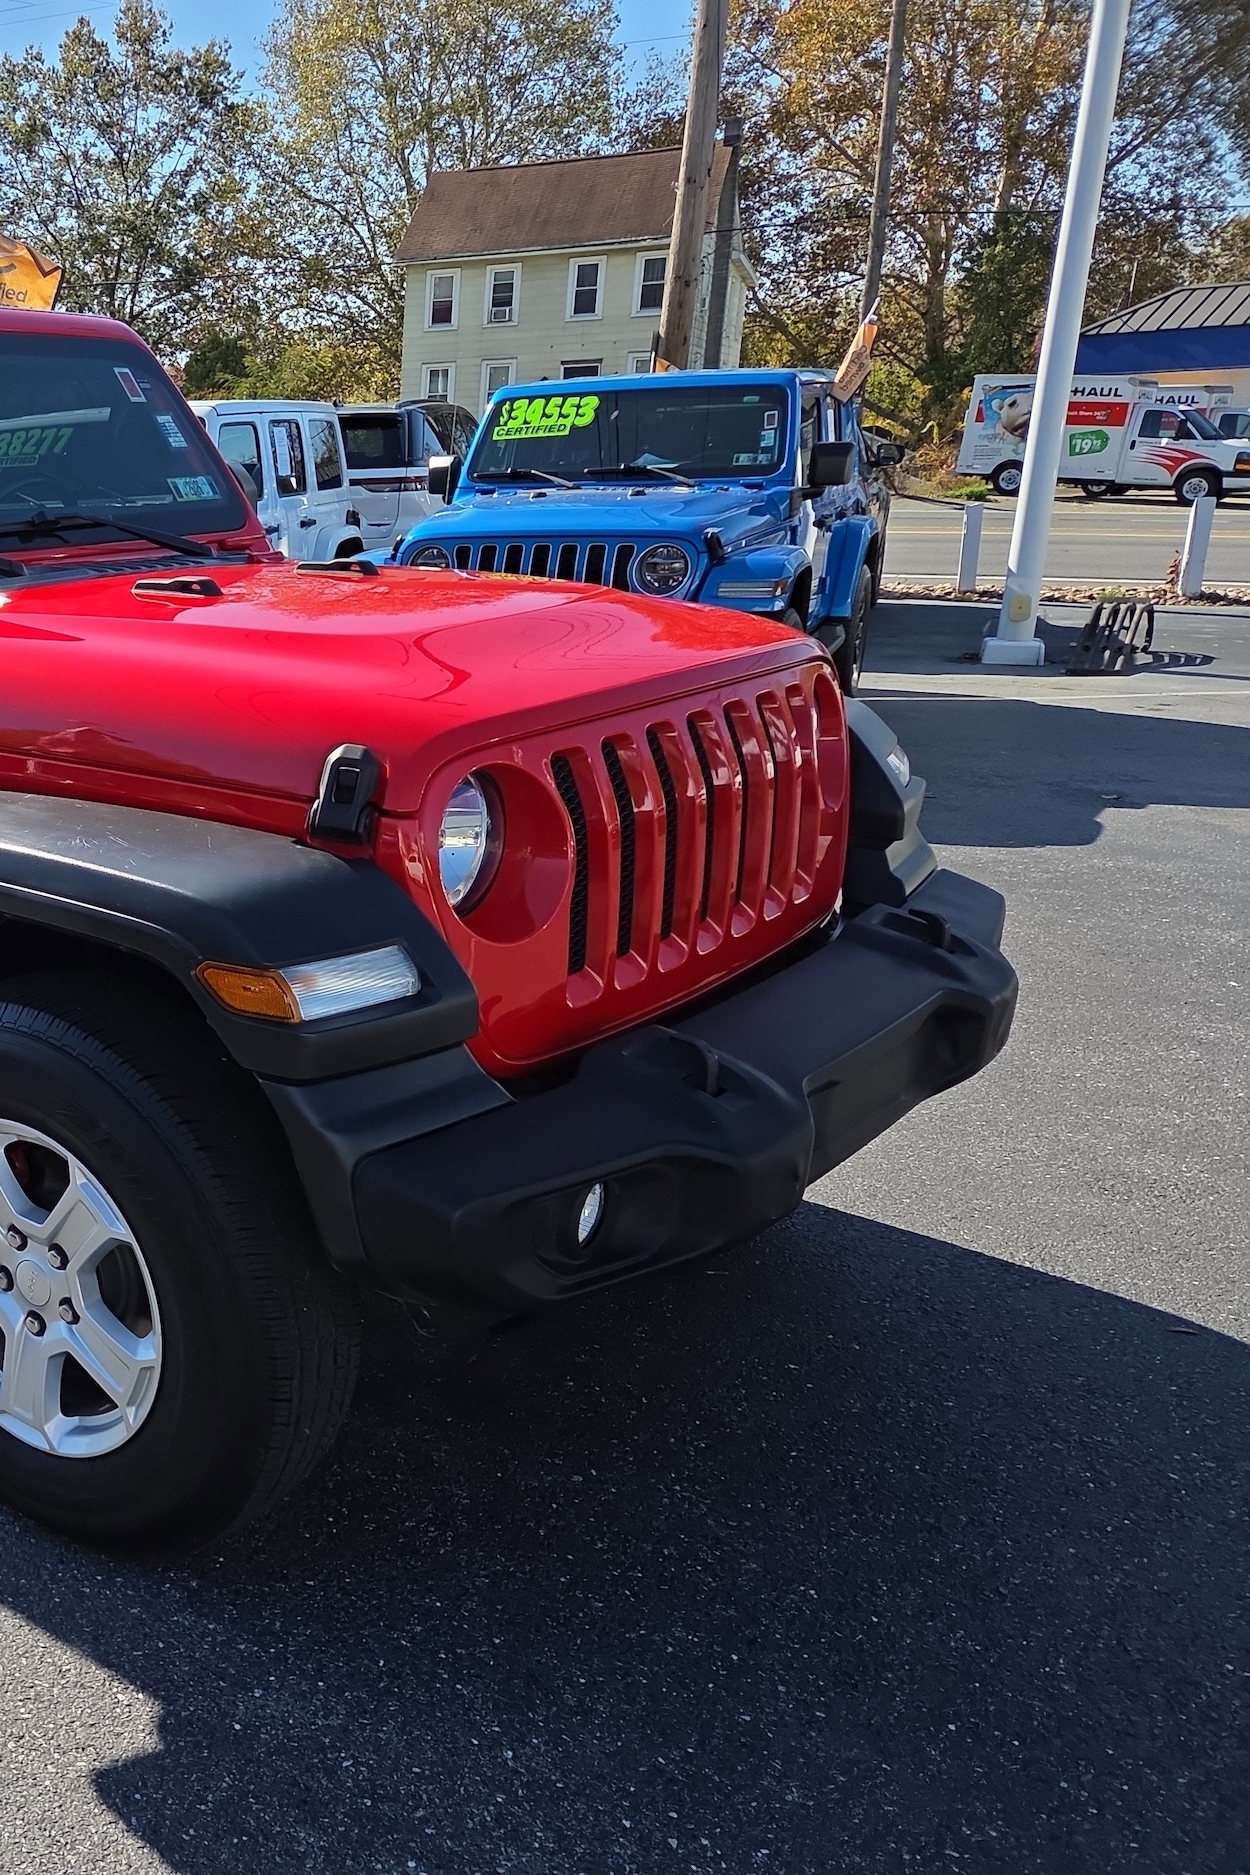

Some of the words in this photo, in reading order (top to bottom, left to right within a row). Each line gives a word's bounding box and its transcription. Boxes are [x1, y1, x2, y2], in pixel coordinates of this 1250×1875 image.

[1071, 386, 1123, 398] -HAUL
[1155, 395, 1200, 405] HAUL
[495, 423, 567, 437] CERTIFIED
